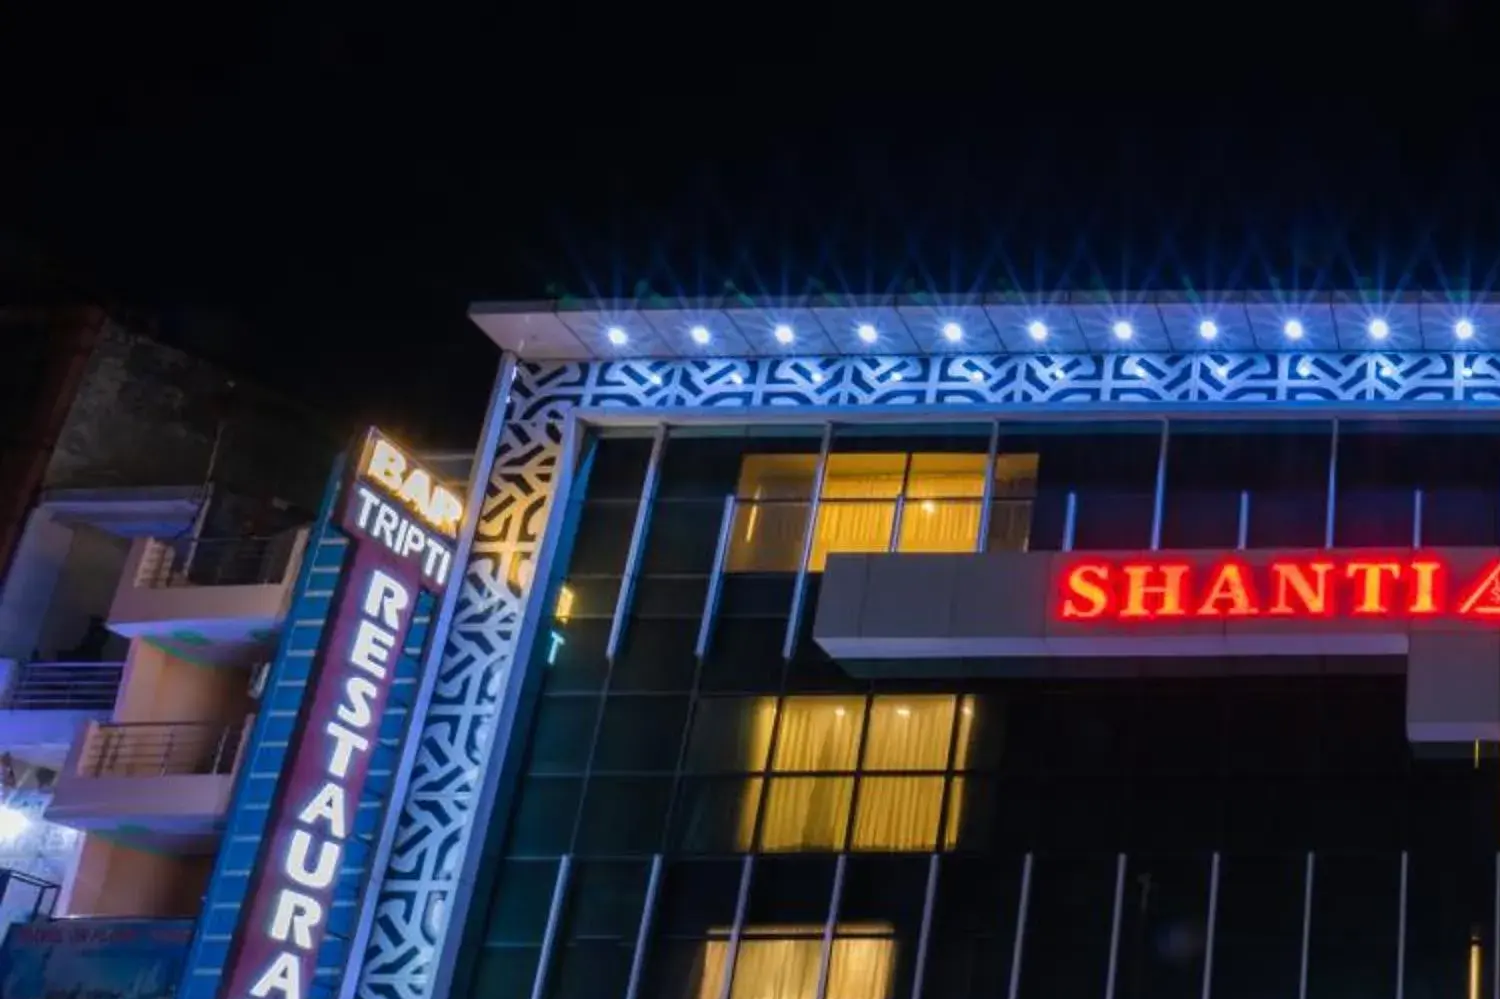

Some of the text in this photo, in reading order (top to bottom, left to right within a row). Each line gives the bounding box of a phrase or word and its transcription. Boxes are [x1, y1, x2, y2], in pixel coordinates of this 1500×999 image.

[358, 487, 451, 584] TRIPTI
[367, 440, 463, 538] BAR
[1061, 562, 1440, 618] SHANTI
